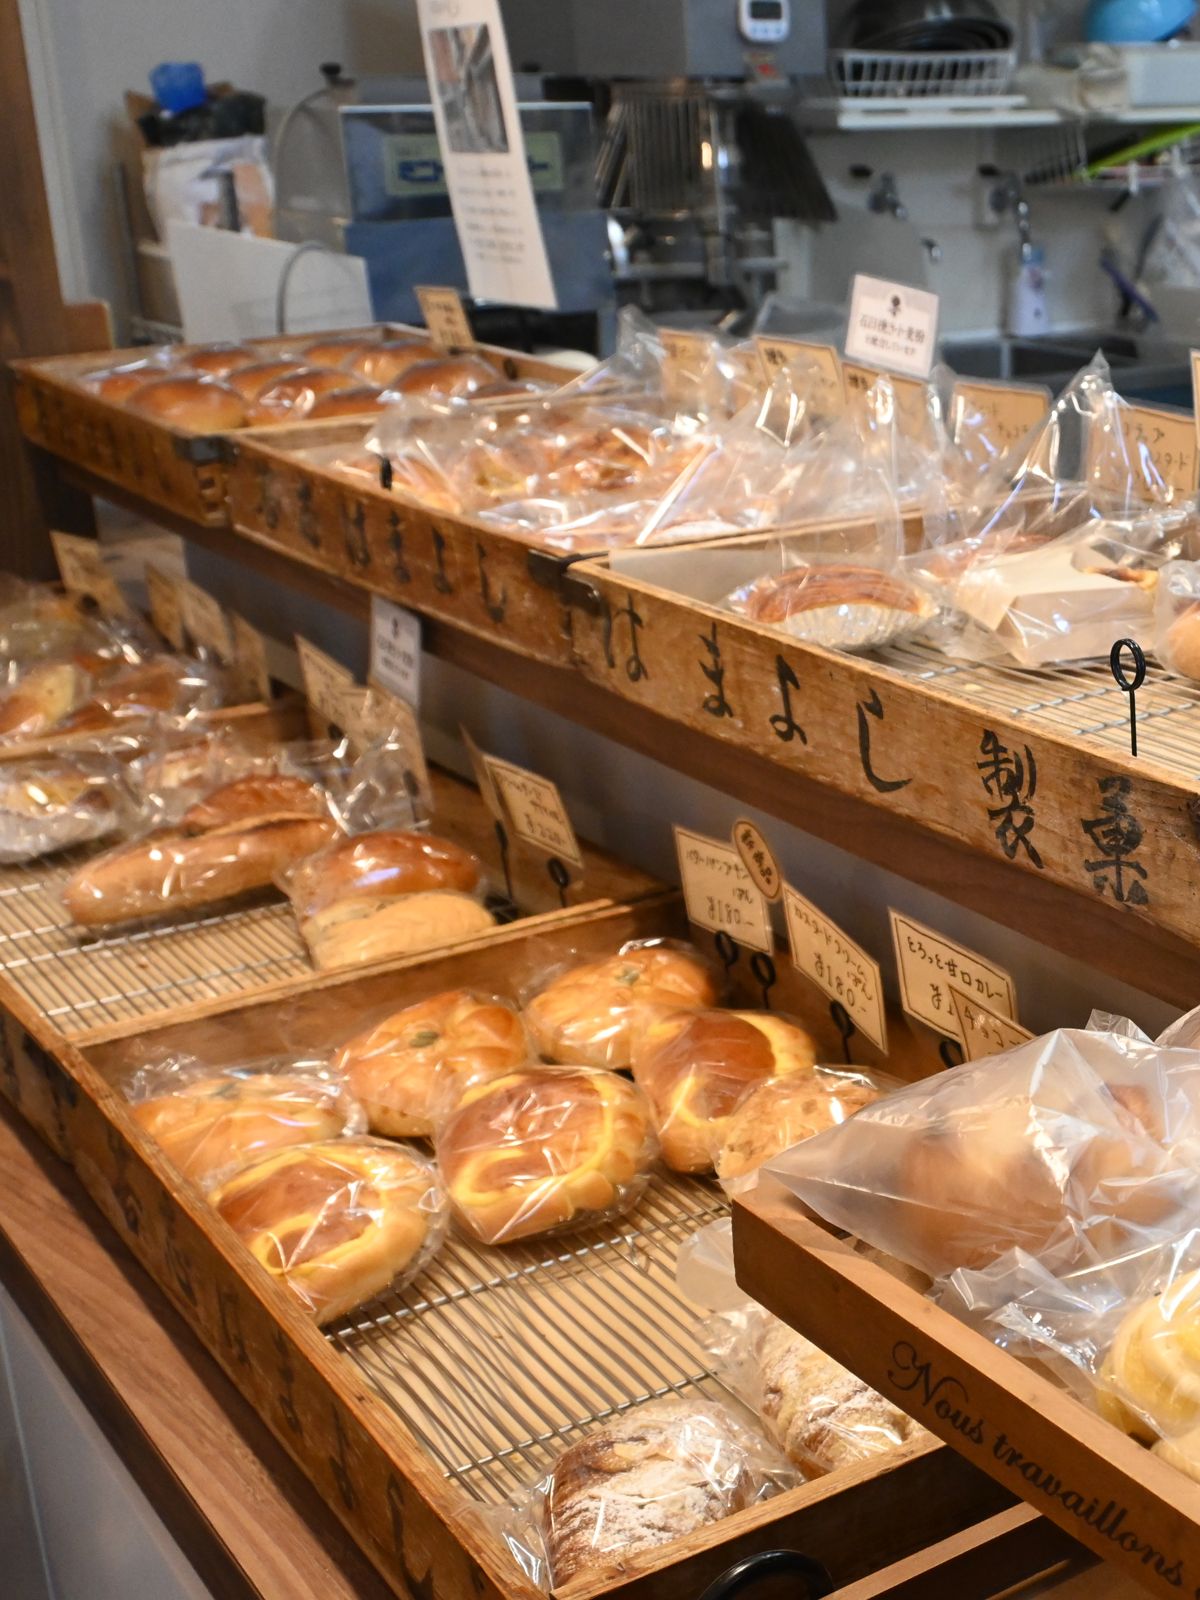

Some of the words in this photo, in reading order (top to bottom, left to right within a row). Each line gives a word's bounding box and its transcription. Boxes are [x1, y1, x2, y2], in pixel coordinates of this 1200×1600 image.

[907, 936, 1003, 999] とろっと甘口カレー
[887, 1340, 986, 1446] Nous
[993, 1433, 1184, 1588] travaillons
